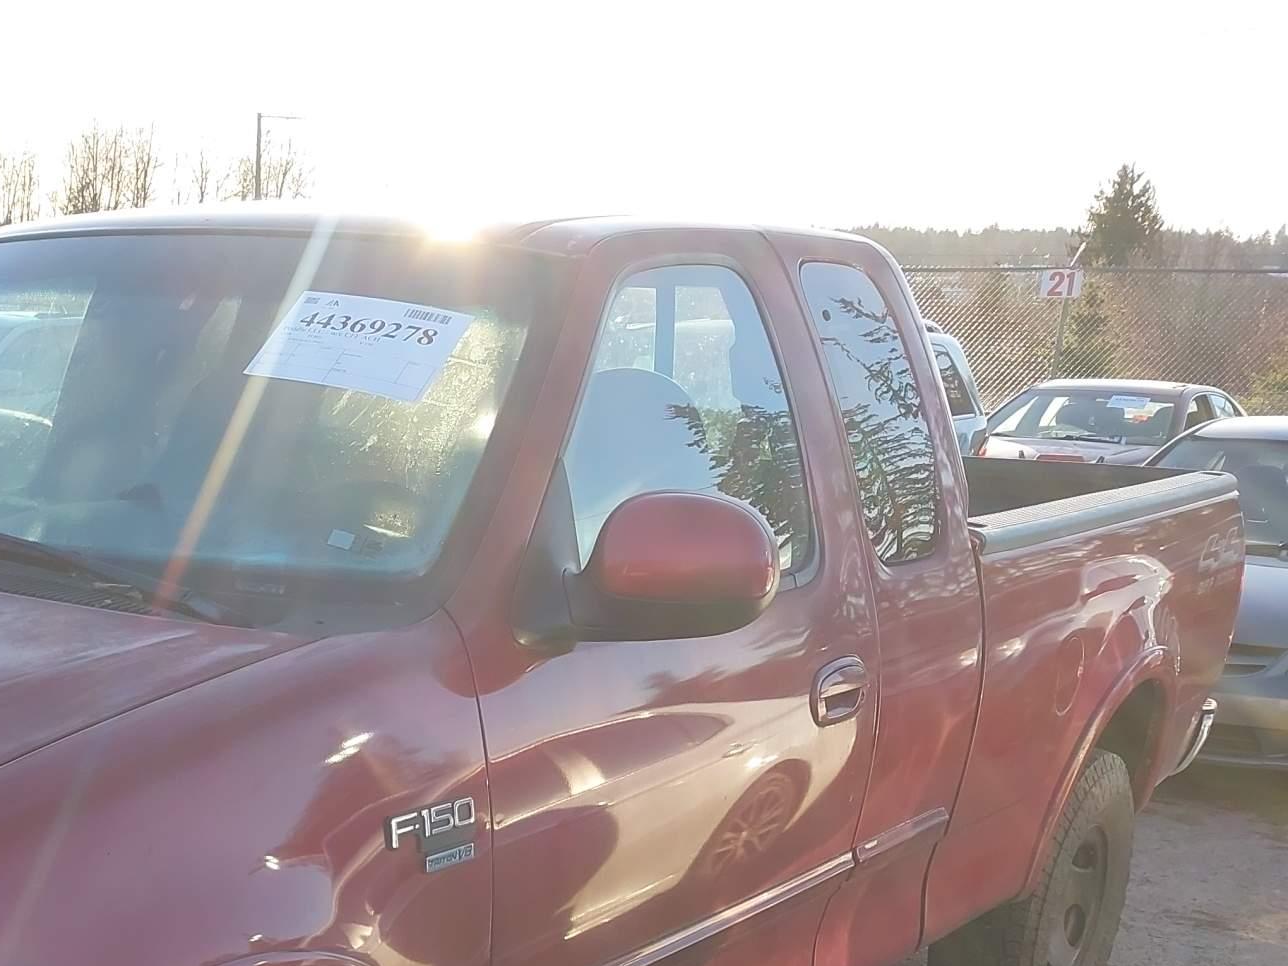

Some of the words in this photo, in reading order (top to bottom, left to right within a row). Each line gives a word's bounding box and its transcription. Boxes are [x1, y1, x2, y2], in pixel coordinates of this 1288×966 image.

[1047, 271, 1075, 296] 21
[300, 311, 439, 346] 44369278
[391, 797, 475, 849] F-150
